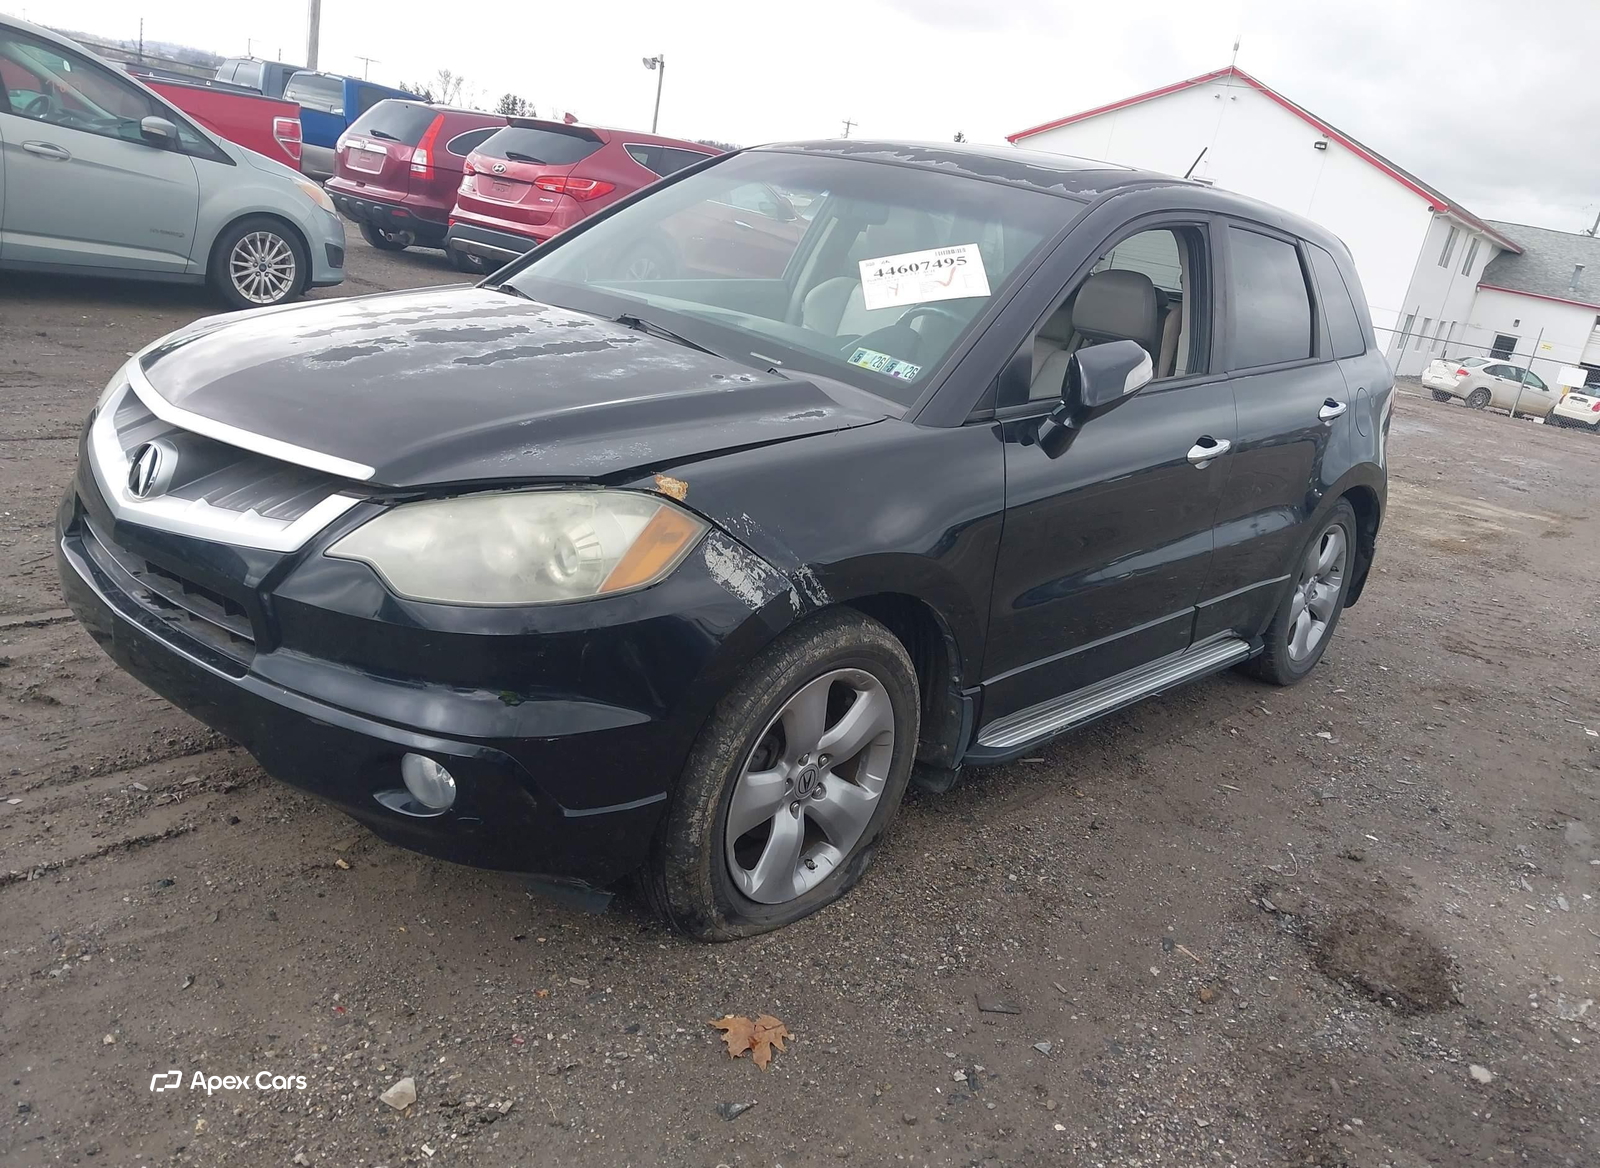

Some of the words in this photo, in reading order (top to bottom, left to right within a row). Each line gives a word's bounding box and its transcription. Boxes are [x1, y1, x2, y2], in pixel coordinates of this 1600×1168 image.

[873, 256, 967, 278] 44607495
[872, 356, 886, 369] 26
[904, 366, 919, 379] 26
